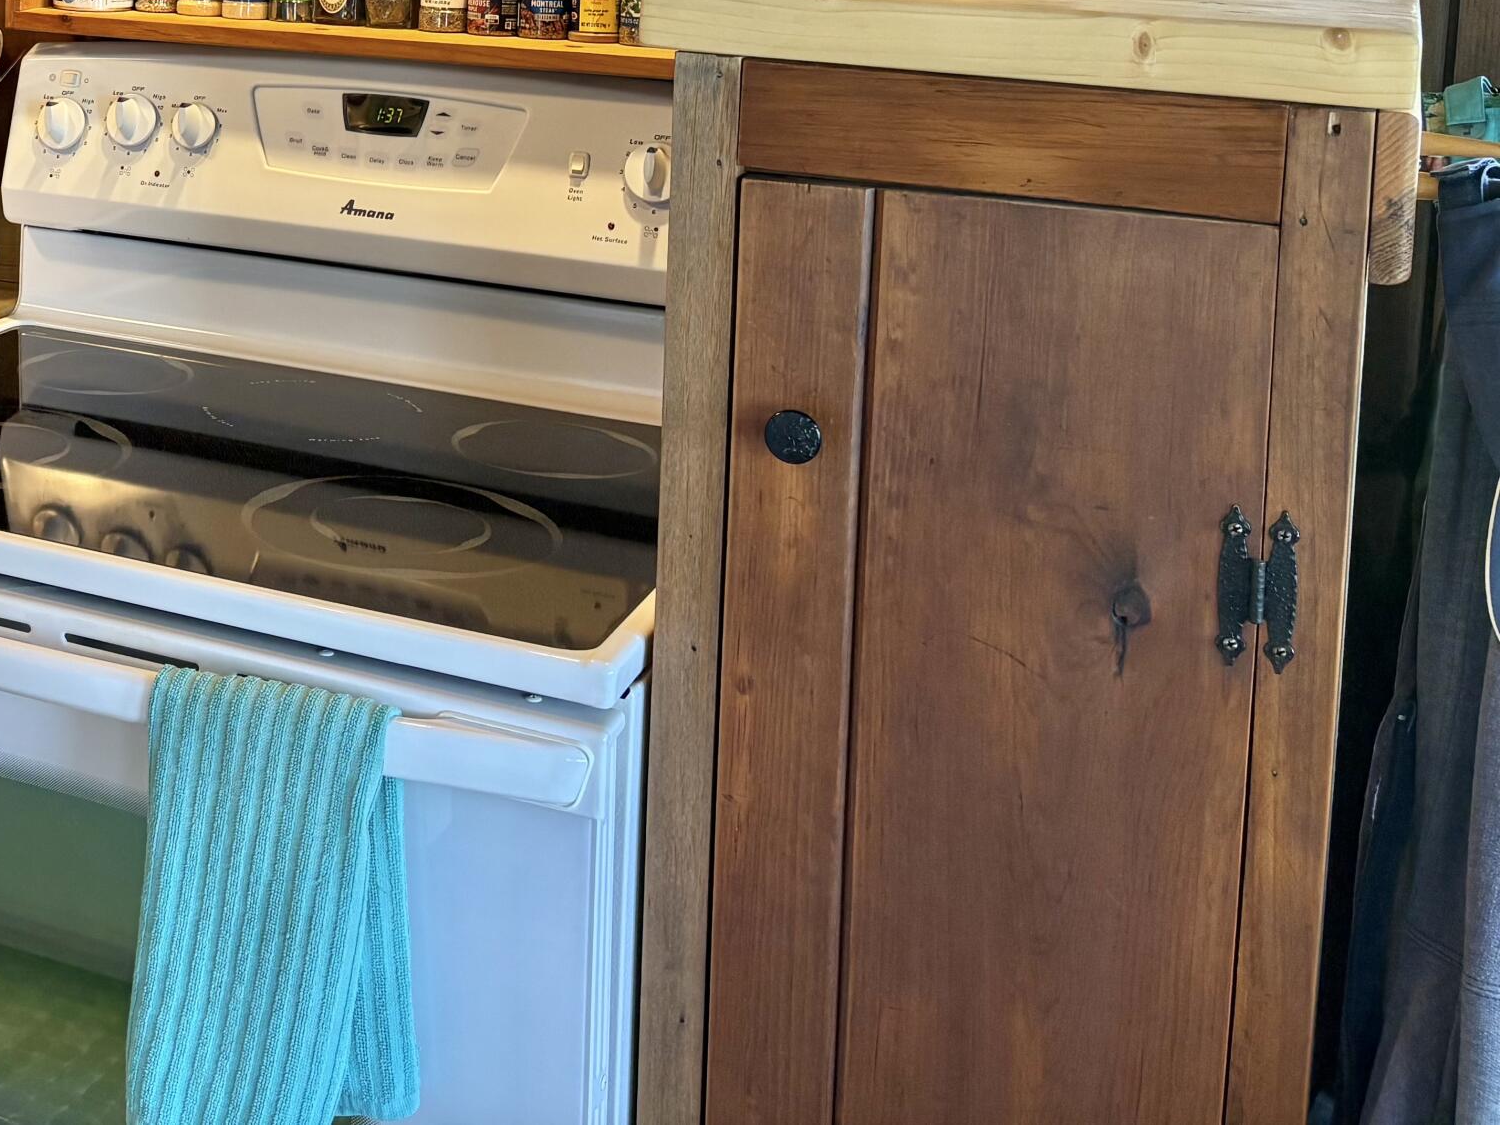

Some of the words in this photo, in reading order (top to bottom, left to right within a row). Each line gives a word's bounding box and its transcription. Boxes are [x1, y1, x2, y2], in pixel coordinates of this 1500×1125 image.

[531, 0, 564, 8] MONTREAL
[377, 107, 403, 124] 1:37
[369, 157, 385, 165] Delay
[455, 154, 476, 162] Cancel
[340, 199, 395, 220] Amana
